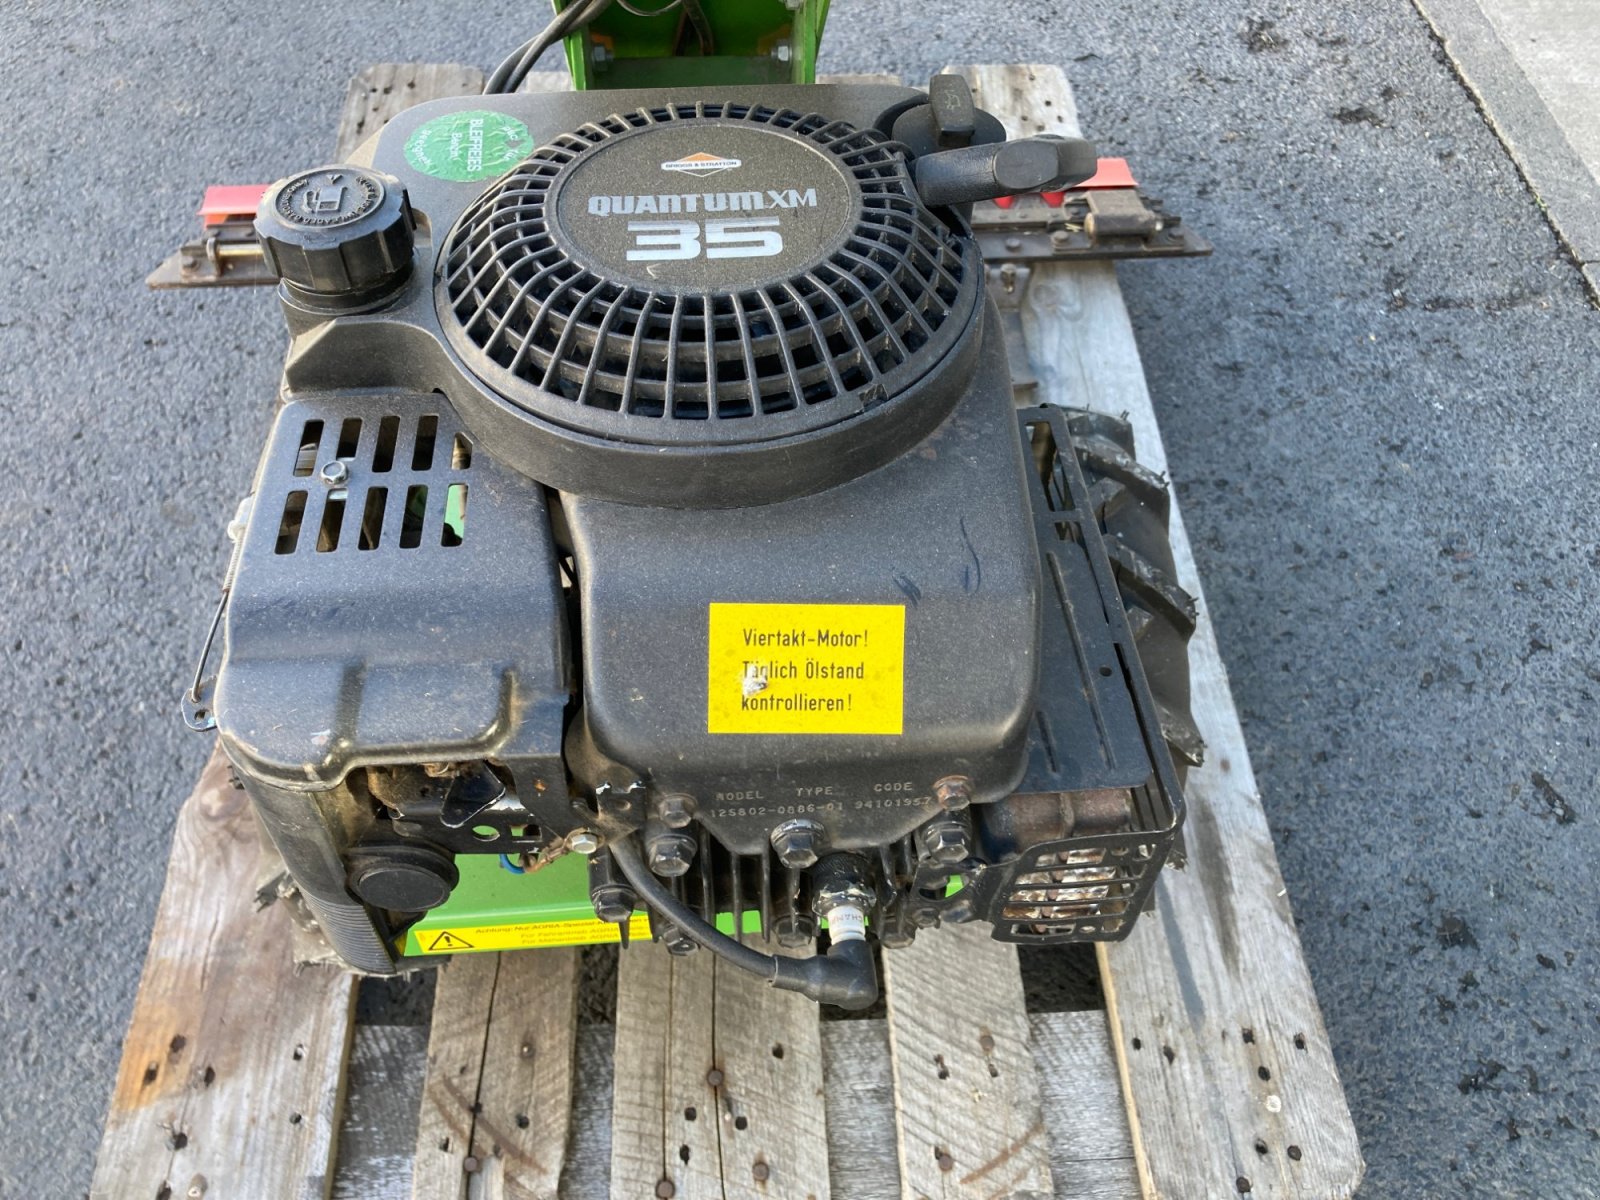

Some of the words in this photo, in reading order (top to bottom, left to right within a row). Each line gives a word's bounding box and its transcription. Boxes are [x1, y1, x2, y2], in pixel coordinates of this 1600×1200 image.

[450, 132, 462, 160] Benzin
[467, 118, 484, 172] BLEIFREIES
[626, 216, 784, 261] 35
[743, 628, 869, 647] Viertakt-Motor!
[805, 658, 865, 679] Ölstand
[741, 693, 853, 711] kontrollieren!
[715, 790, 764, 801] MODEL
[796, 786, 833, 797] TYPE
[873, 782, 913, 792] CODE
